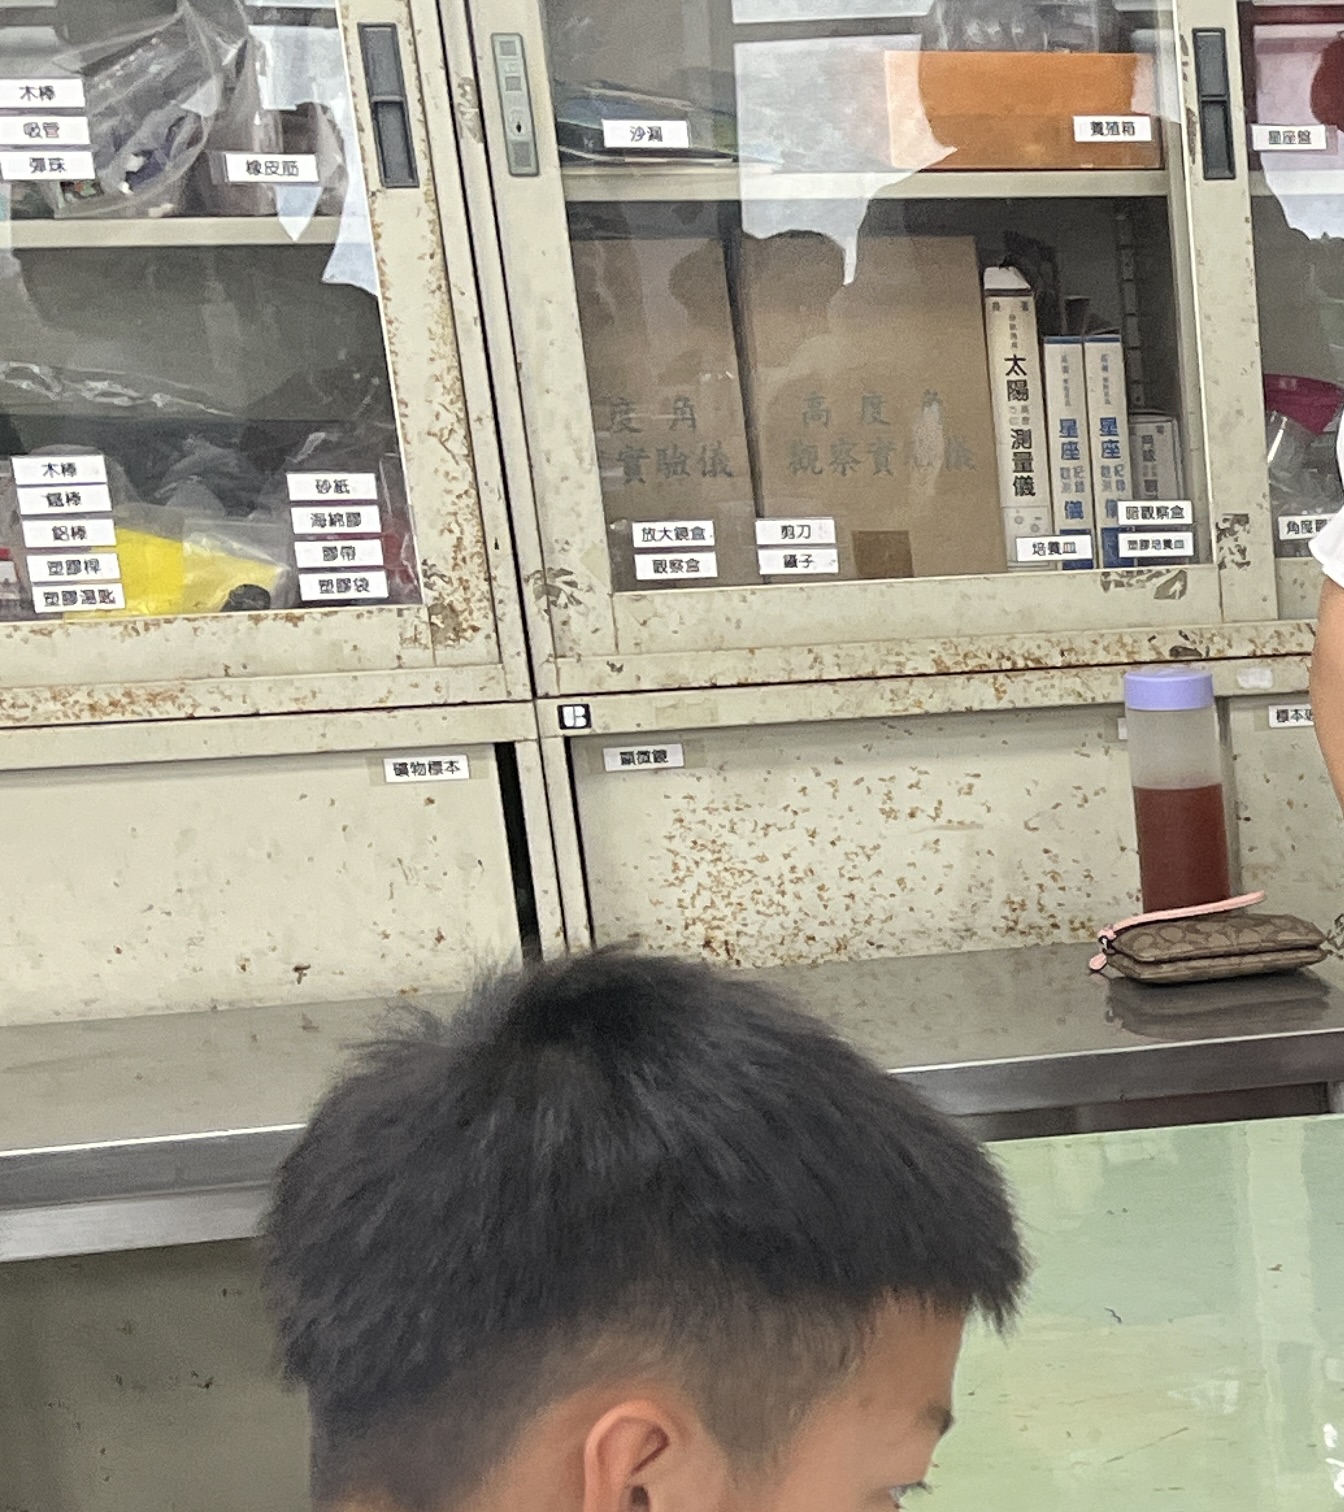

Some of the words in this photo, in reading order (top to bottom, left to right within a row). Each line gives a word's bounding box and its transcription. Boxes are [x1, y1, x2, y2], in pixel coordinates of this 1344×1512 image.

[19, 85, 55, 101] 木棒
[41, 462, 77, 478] 木棒
[642, 526, 706, 542] 放大鏡盒
[780, 524, 811, 539] 剪刀
[652, 558, 700, 574] 觀察盒
[562, 705, 588, 728] B
